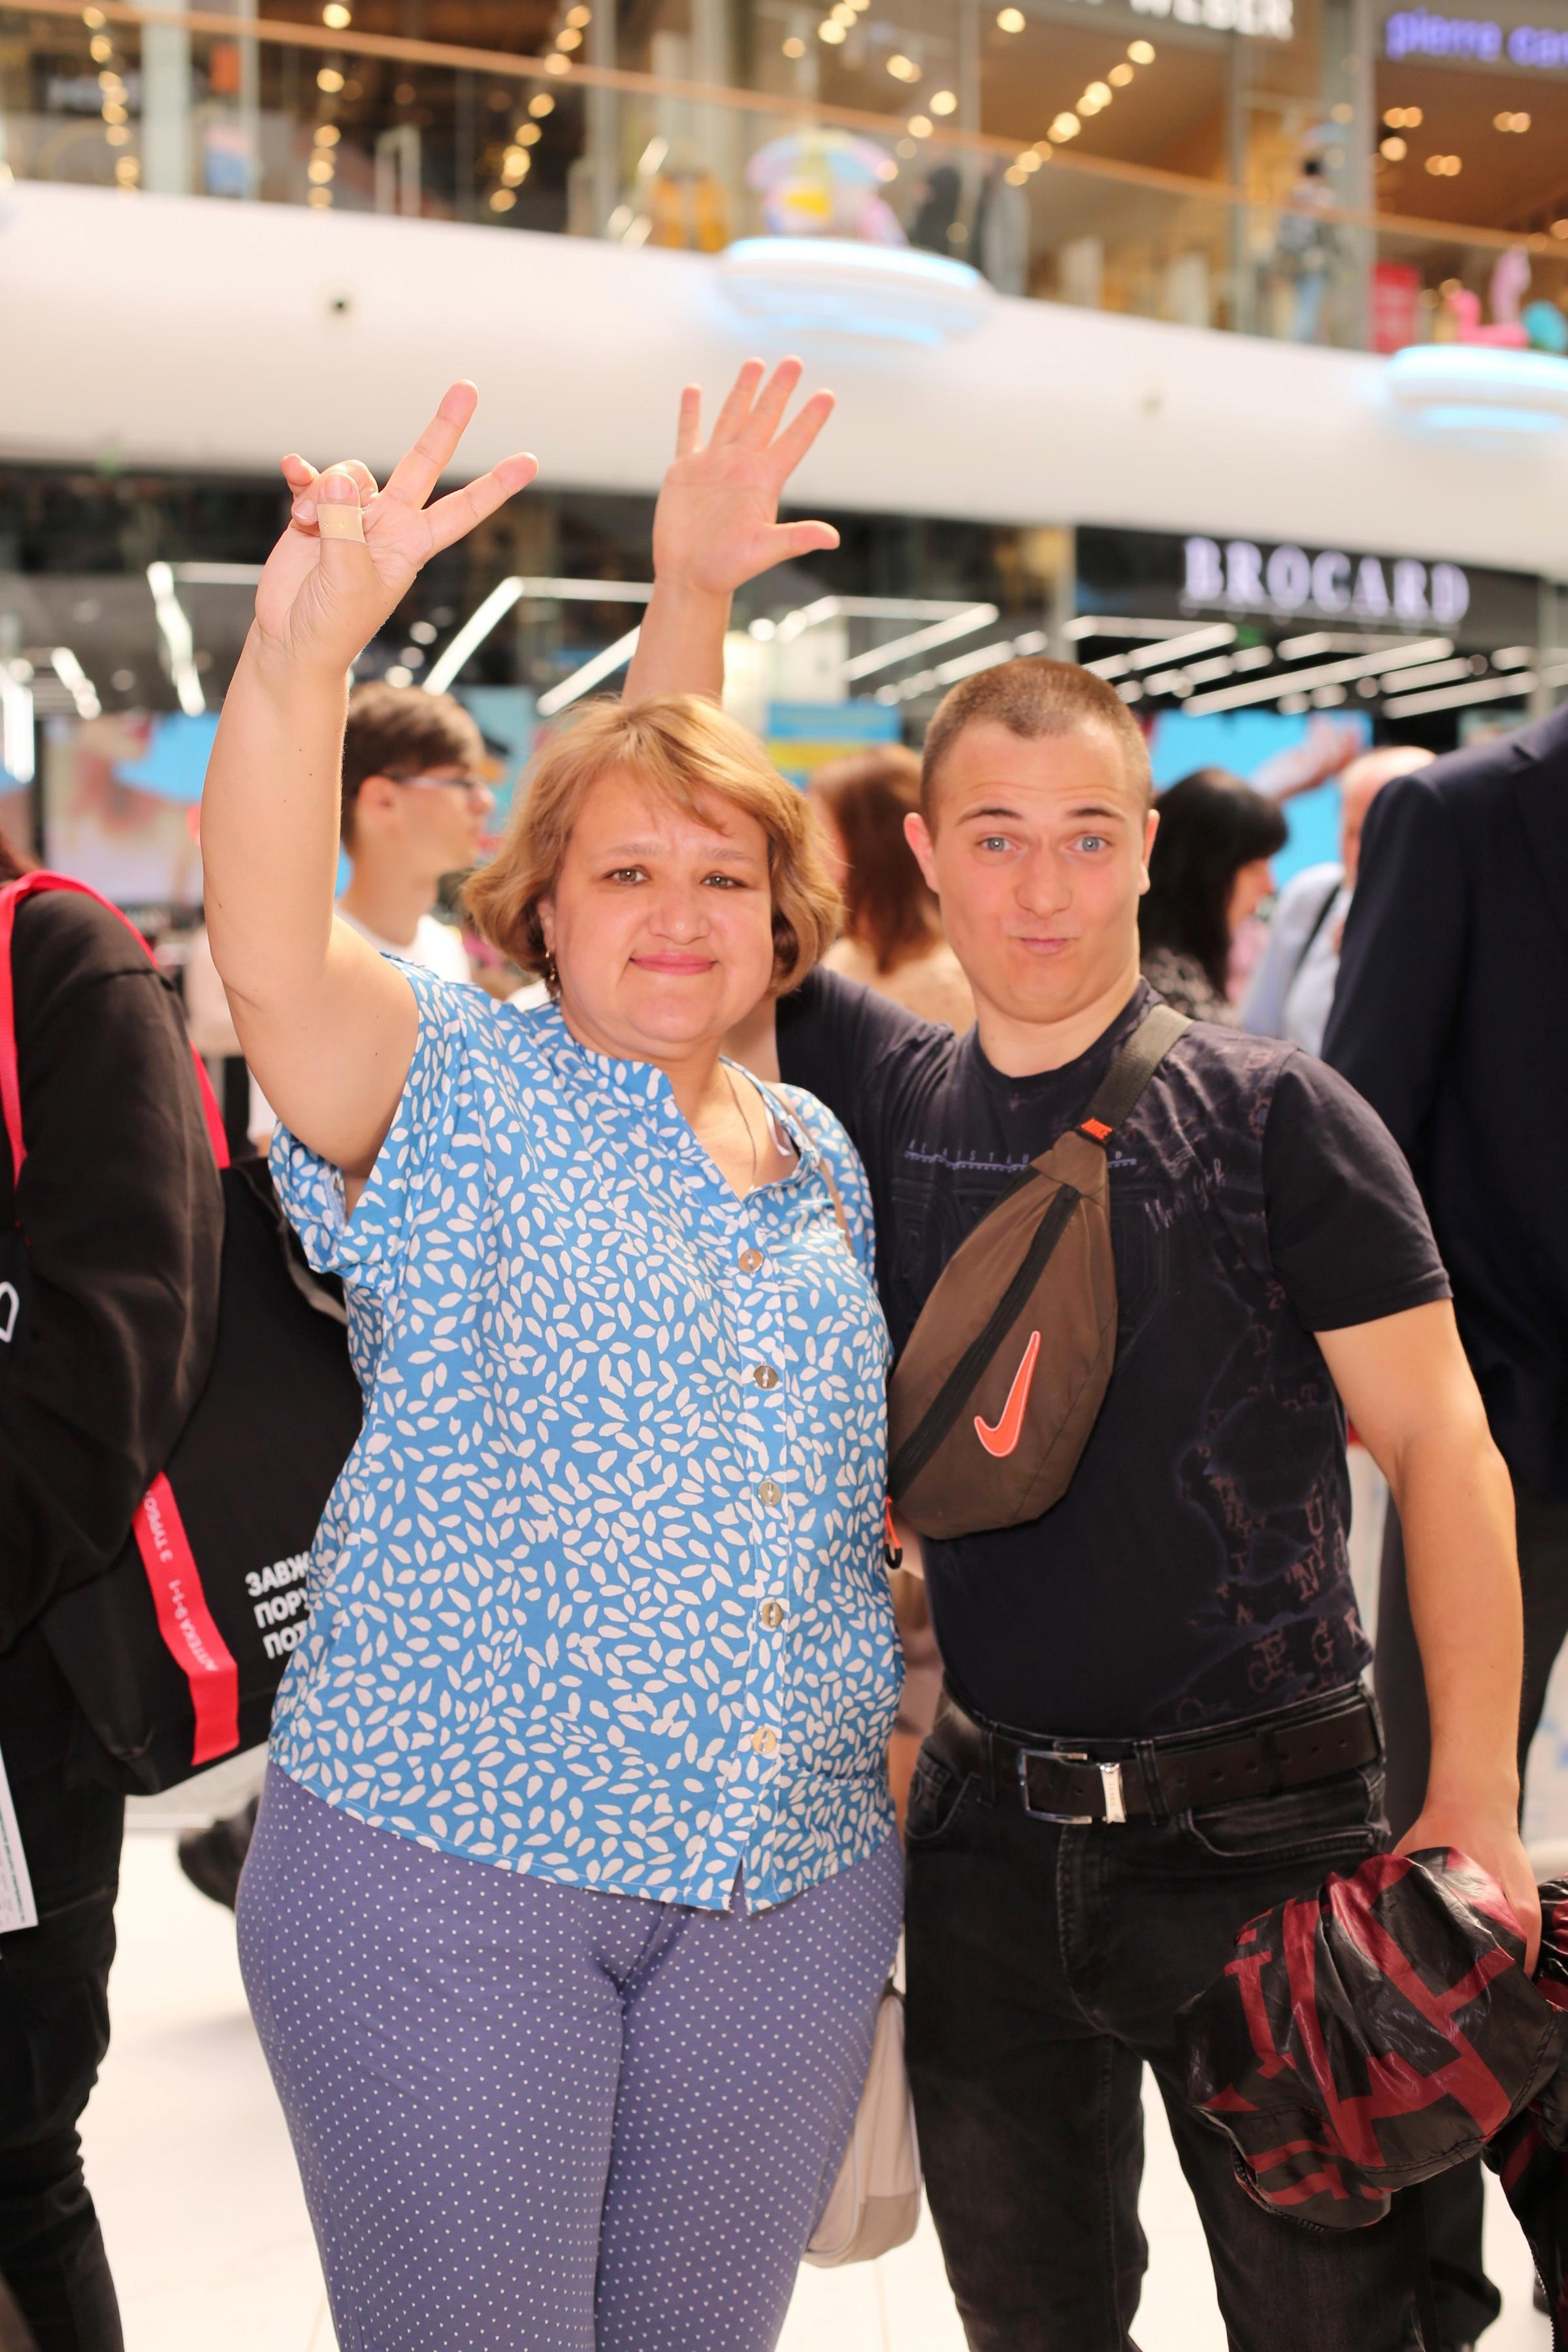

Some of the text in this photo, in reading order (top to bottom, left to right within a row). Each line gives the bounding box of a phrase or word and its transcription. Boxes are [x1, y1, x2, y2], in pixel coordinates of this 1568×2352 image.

[1386, 7, 1502, 61] pierre
[1184, 536, 1469, 624] BROCARD
[143, 1490, 169, 1551] ТУРБО
